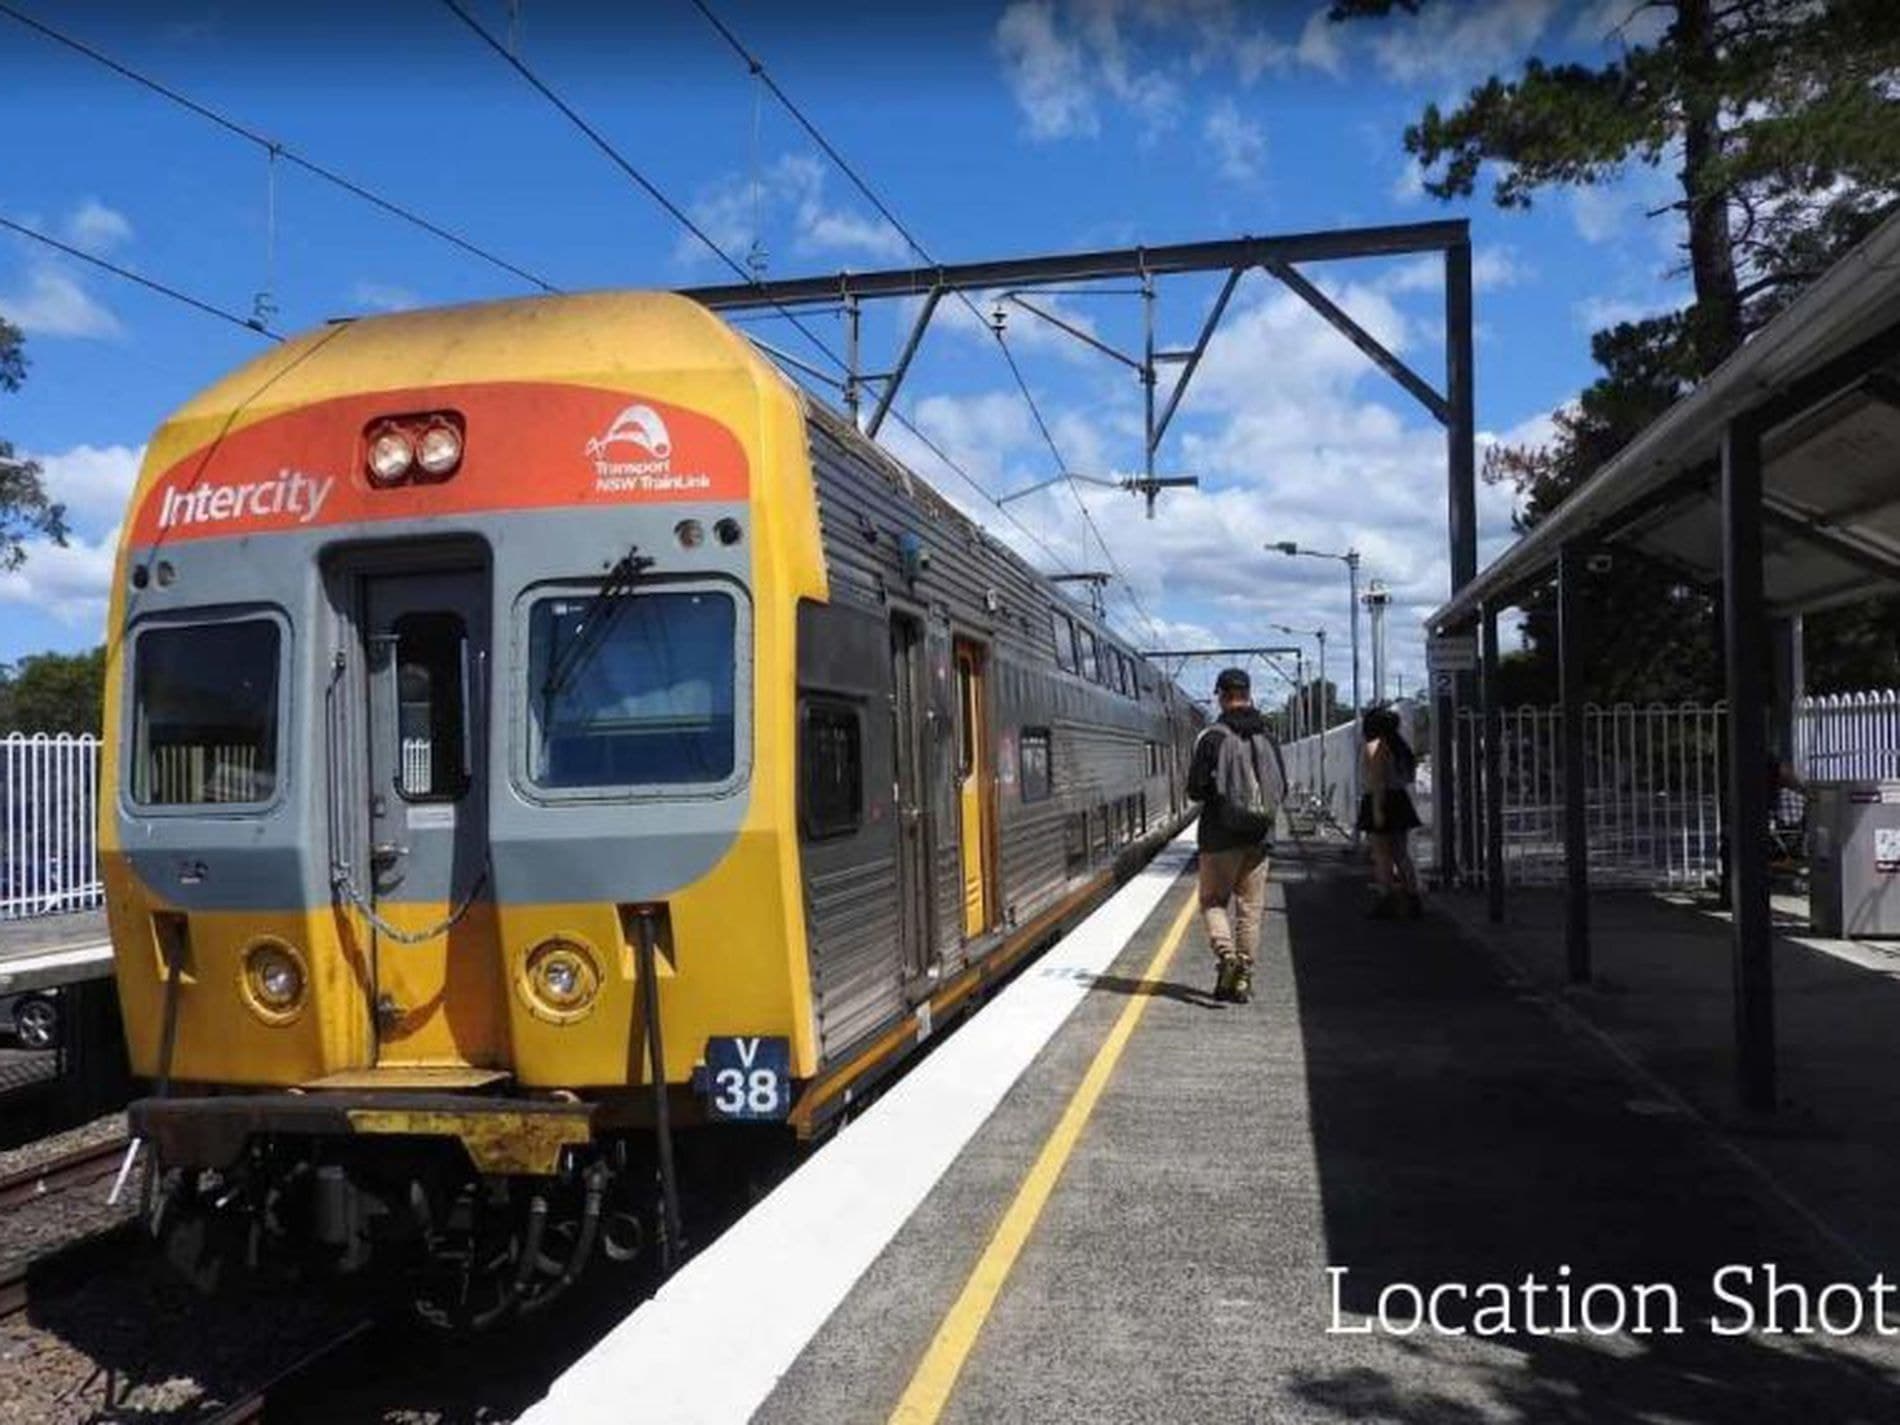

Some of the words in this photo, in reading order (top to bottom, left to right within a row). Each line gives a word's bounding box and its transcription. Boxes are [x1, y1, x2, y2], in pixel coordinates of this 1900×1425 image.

[595, 460, 670, 476] Transport
[596, 477, 637, 491] NSW
[638, 473, 711, 489] TrainLink
[158, 469, 335, 528] Intercity
[734, 1037, 760, 1068] V
[715, 1068, 779, 1113] 38
